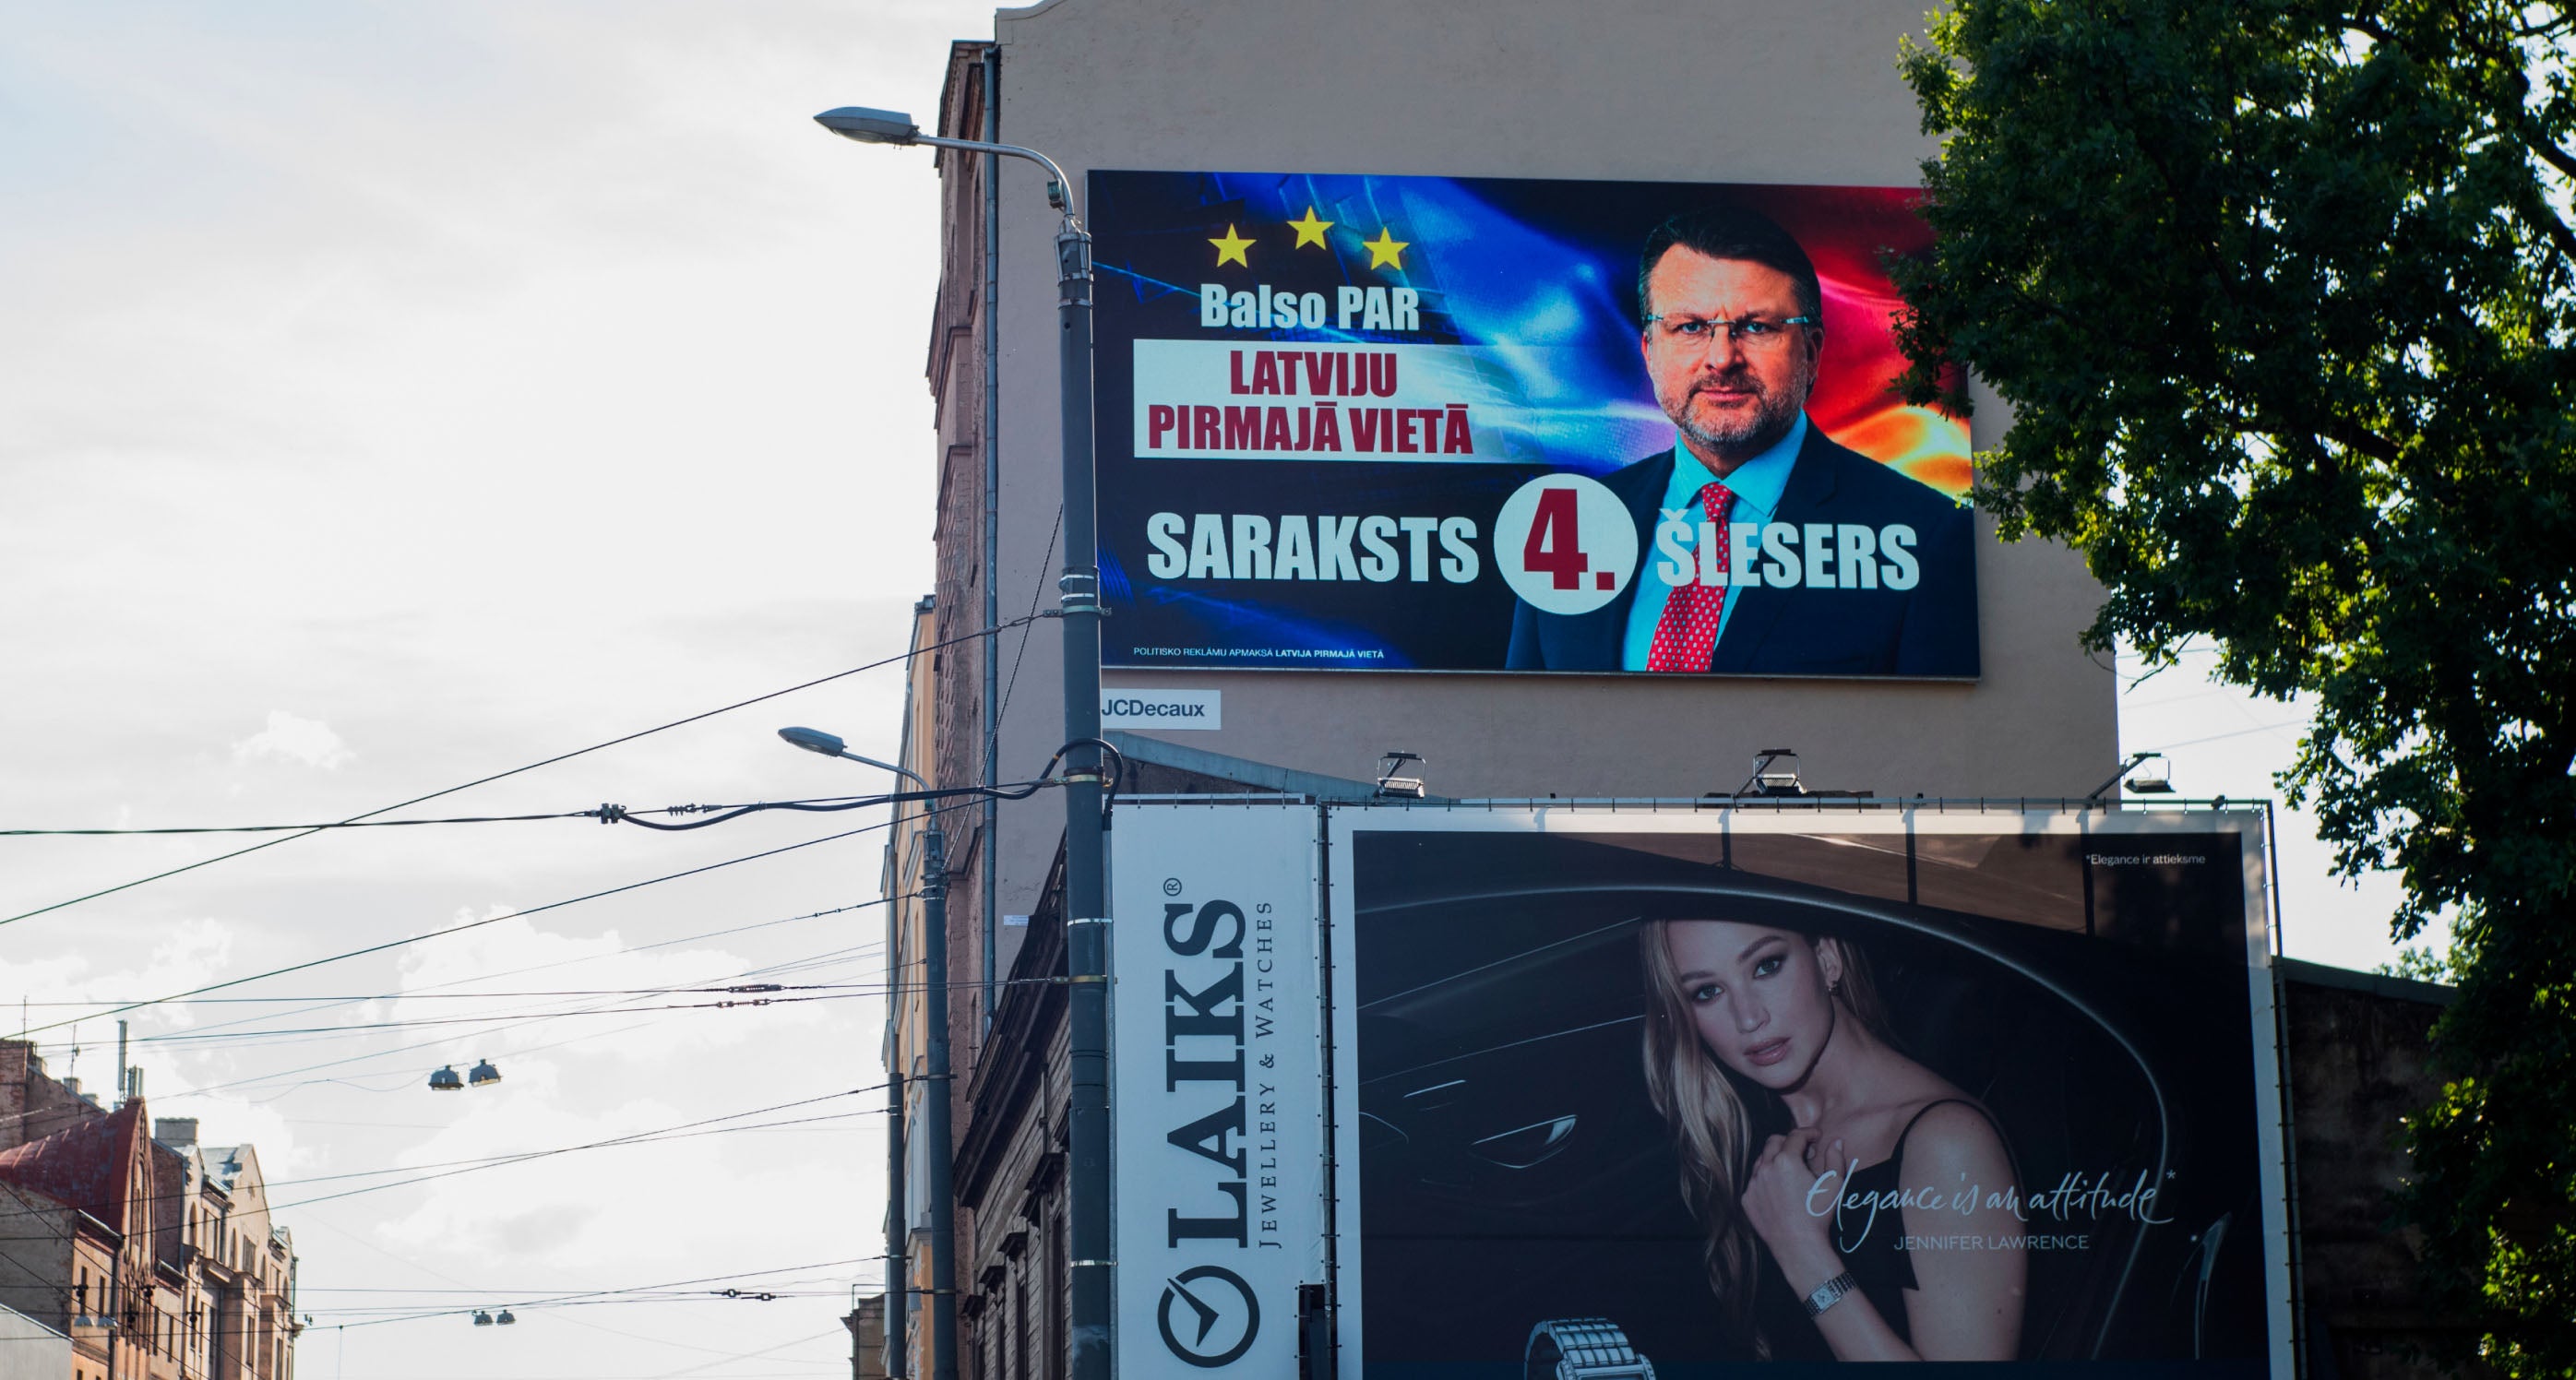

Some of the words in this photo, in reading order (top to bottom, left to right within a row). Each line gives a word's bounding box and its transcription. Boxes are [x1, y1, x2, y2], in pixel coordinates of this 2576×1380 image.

[1200, 283, 1326, 329] Balso
[1338, 285, 1419, 331] PAR
[1230, 350, 1397, 397] LATVIJU
[1149, 400, 1342, 452] PIRMAJĀ
[1349, 403, 1473, 454] VIETĀ
[1147, 512, 1479, 583] SARAKSTS
[1523, 488, 1616, 590] 4.
[1656, 508, 1920, 590] ŠLESERS
[1133, 647, 1182, 656] POLITISKO
[1183, 647, 1227, 657] REKLĀMU
[1229, 648, 1273, 658] APMAKSĀ
[1275, 649, 1312, 658] LATVIJA
[1314, 648, 1355, 659] PIRMAJĀ
[1357, 649, 1384, 660] VIETĀ
[1102, 699, 1205, 717] JCDecaux
[2142, 854, 2151, 864] ir
[2153, 854, 2205, 865] attieksme
[1256, 901, 1275, 1040] WATCHES
[1258, 1053, 1274, 1069] &
[1258, 1082, 1282, 1249] JEWELLERY
[1805, 1159, 1947, 1254] Elegance
[1951, 1172, 1979, 1217] is
[1985, 1191, 2029, 1222] an
[1893, 1234, 1984, 1251] JENNIFER
[1987, 1235, 2090, 1251] LAWRENCE
